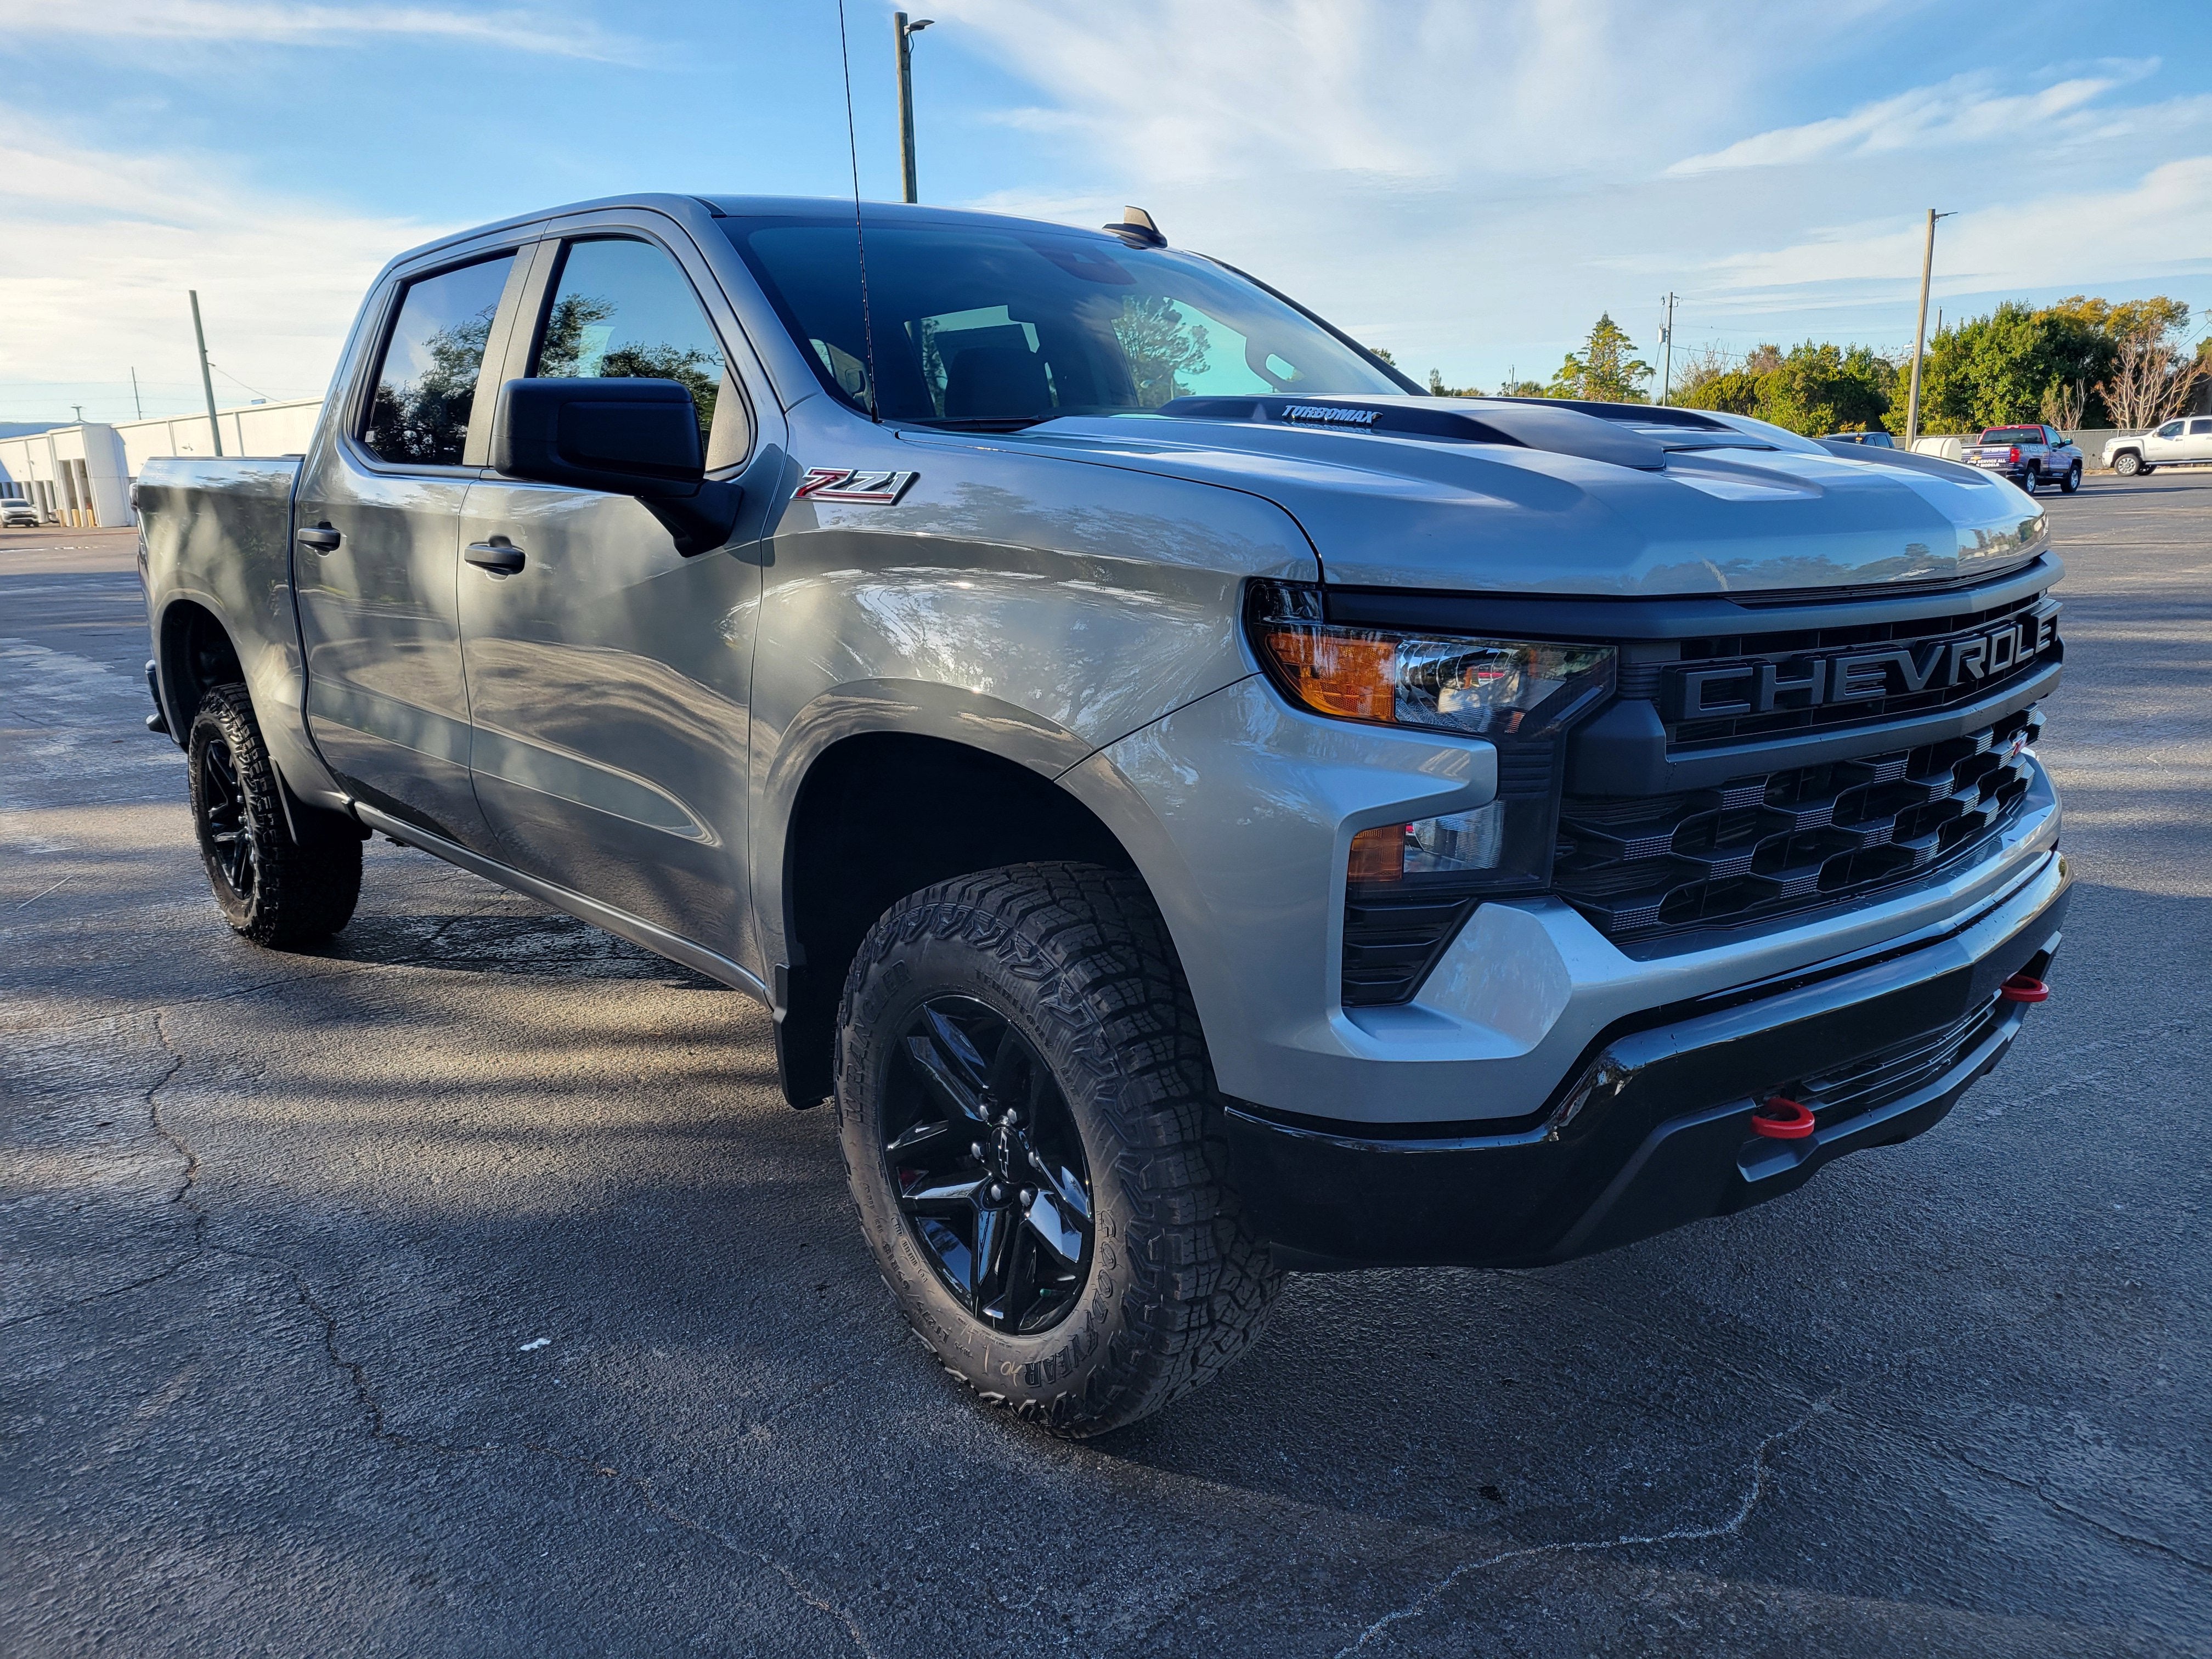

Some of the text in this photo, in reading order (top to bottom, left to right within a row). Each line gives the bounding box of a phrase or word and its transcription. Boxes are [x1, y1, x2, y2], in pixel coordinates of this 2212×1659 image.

[1282, 404, 1384, 425] TURBOMAX
[789, 466, 921, 506] Z71
[843, 959, 912, 1122] WRANGLER
[974, 968, 1053, 1049] TERRITORY
[1024, 1208, 1116, 1387] GOODYEAR
